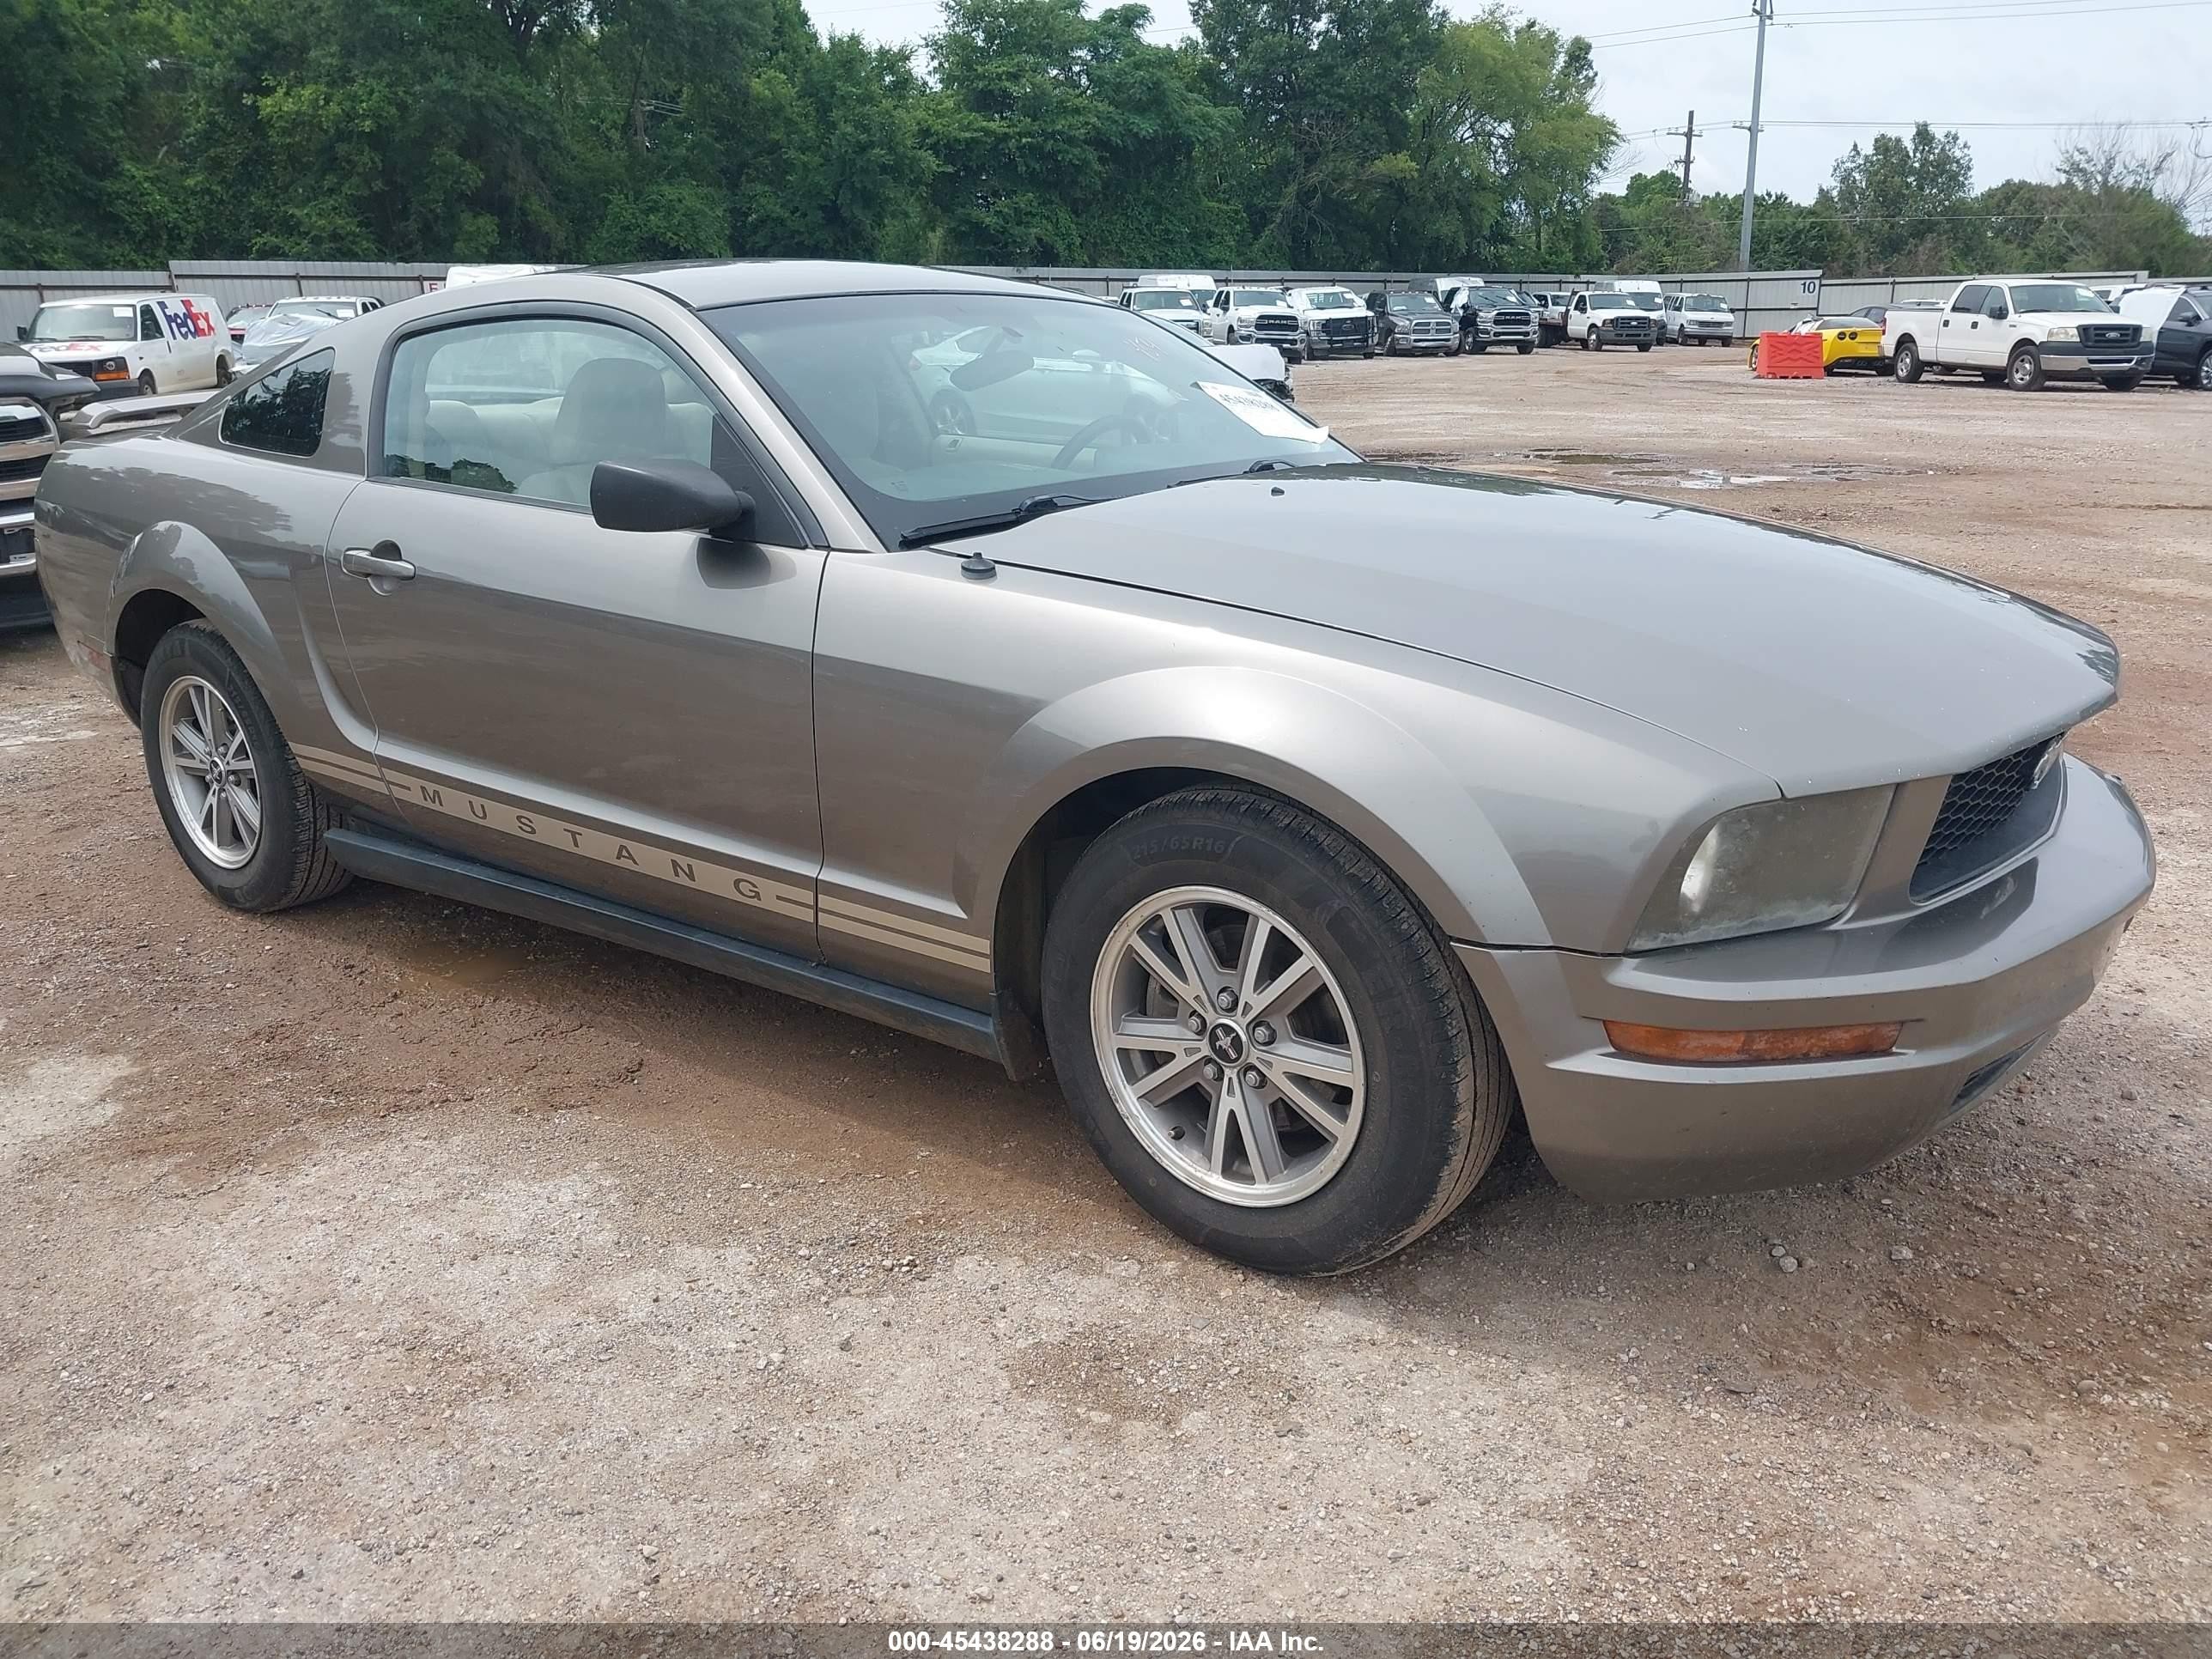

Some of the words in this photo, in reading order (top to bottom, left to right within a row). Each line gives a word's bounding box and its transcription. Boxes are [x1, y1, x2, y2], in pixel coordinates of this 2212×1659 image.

[1801, 281, 1816, 294] 10
[156, 299, 216, 341] FedEx
[419, 785, 763, 902] MUSTANG
